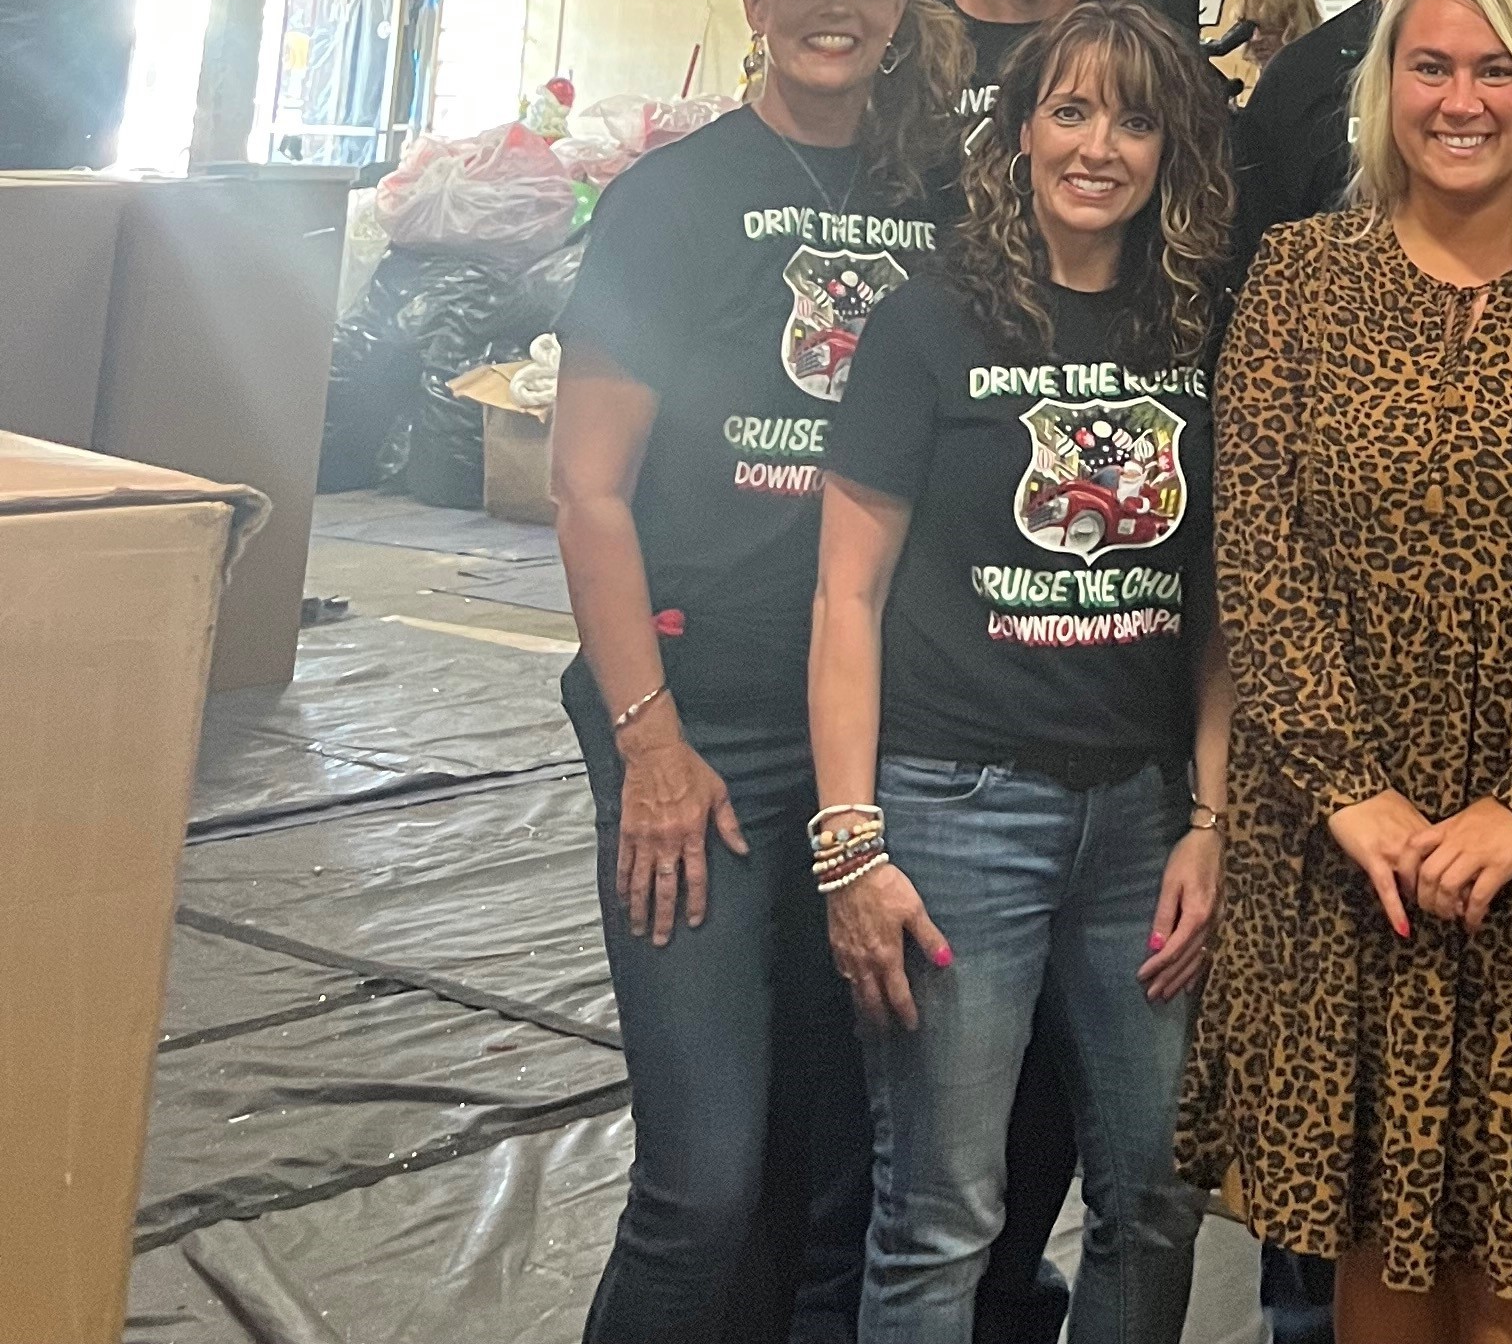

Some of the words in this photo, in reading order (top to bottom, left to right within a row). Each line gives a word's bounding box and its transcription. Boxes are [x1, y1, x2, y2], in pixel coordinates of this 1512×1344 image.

[954, 84, 1000, 114] IVE
[743, 206, 816, 242] DRIVE
[818, 211, 863, 246] THE
[865, 216, 937, 251] ROUTE
[969, 364, 1060, 398] DRIVE
[1062, 362, 1120, 396] THE
[723, 415, 830, 455] CRUISE
[734, 460, 827, 493] DOWNTO
[971, 565, 1073, 605] CRUISE
[1073, 567, 1122, 608] THE
[1121, 565, 1182, 605] CHU
[988, 610, 1112, 647] DOWNTOWN
[1112, 608, 1182, 643] SAPULPA
